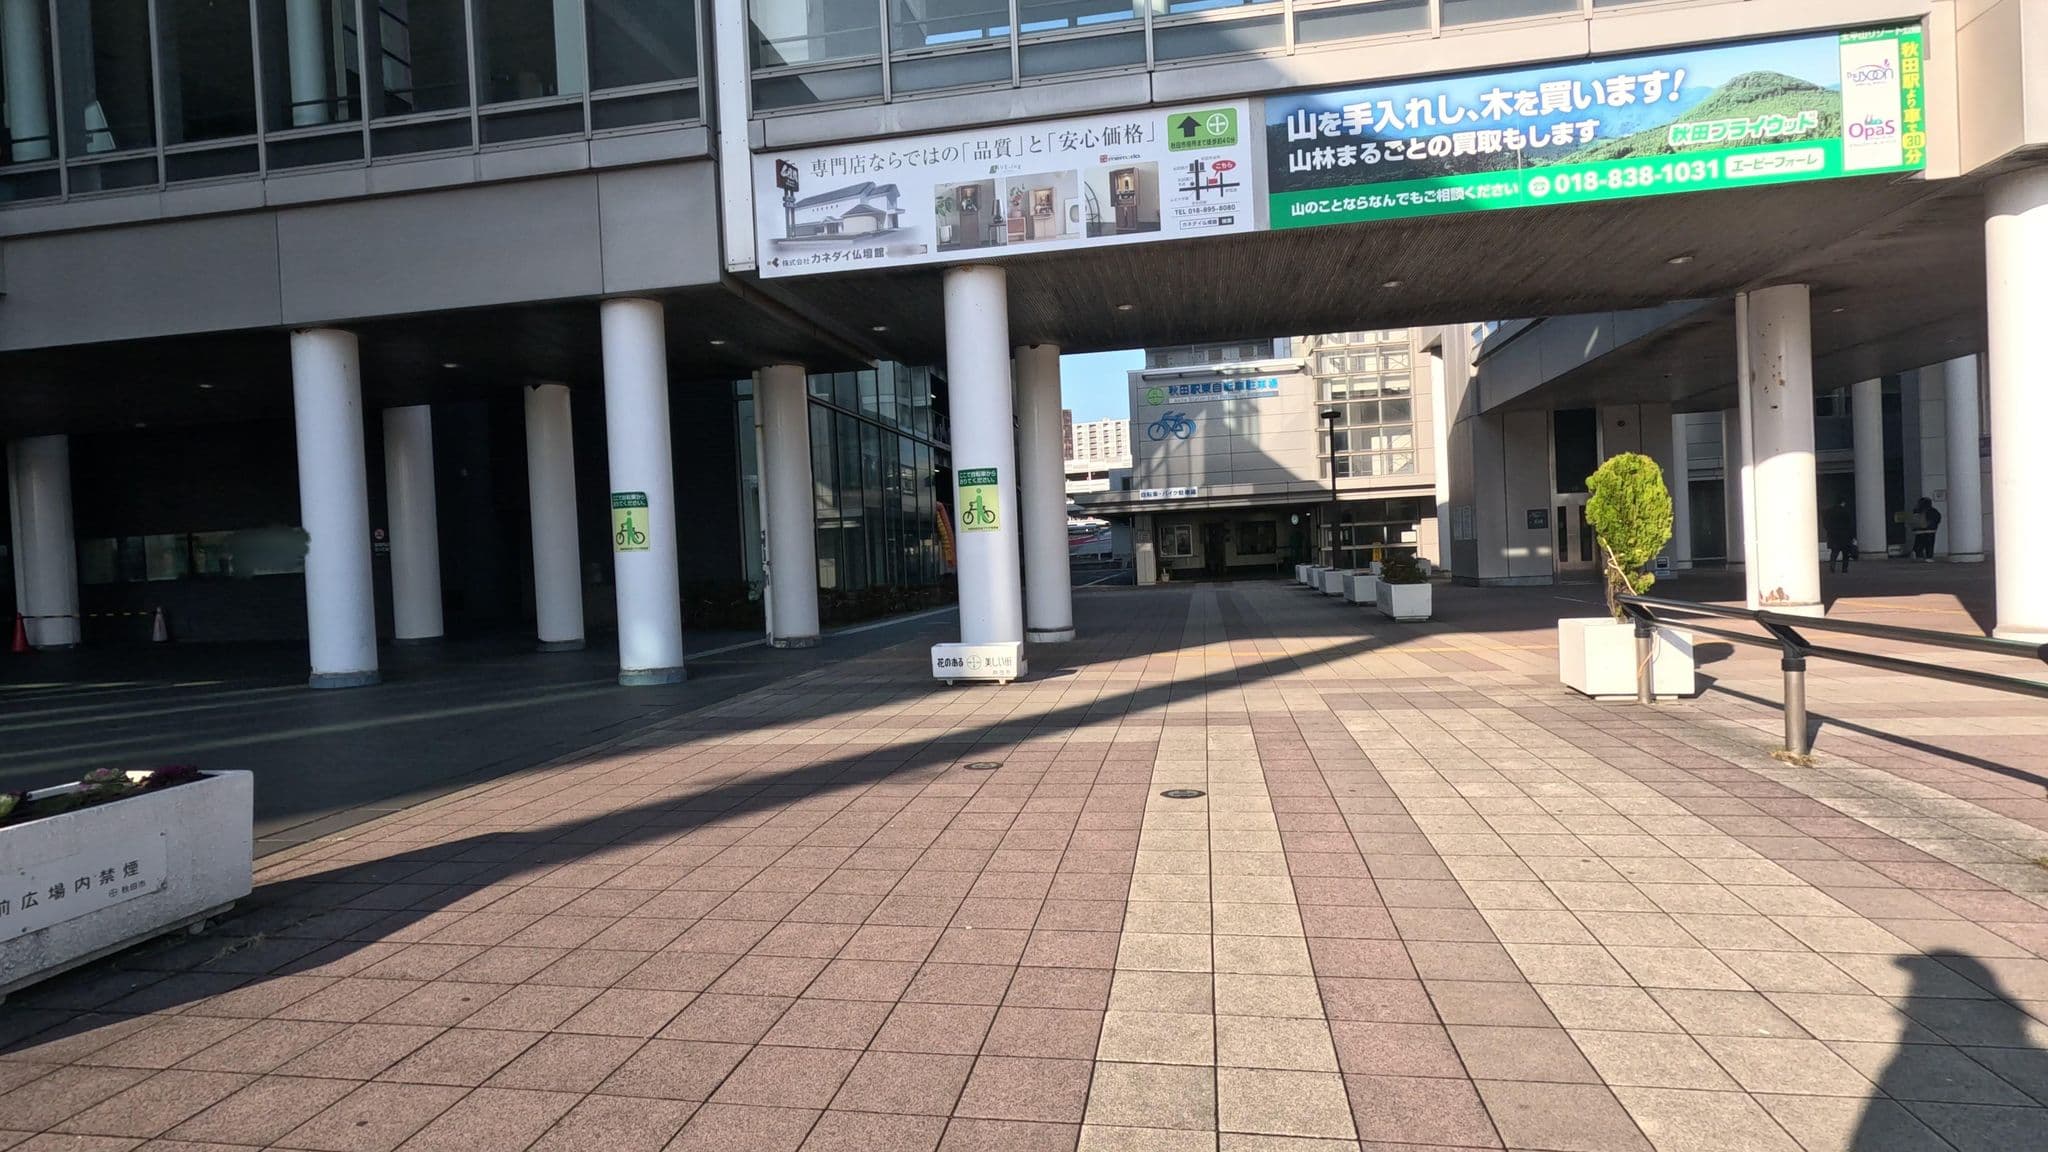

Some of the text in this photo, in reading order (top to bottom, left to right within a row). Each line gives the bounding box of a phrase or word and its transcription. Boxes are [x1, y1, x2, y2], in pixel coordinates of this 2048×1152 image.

[1902, 42, 1922, 164] 秋田駅より車で30分
[1289, 118, 1600, 173] 山林まるごとの買取もします
[1849, 119, 1895, 141] OpaS
[811, 121, 1156, 178] 専門店ならではの「品質」と「安心価格」
[1555, 159, 1719, 194] 018-838-1031
[1291, 182, 1519, 217] 山のことならなんでもご相談ください
[937, 657, 963, 668] 花のある
[121, 878, 147, 894] 秋田市
